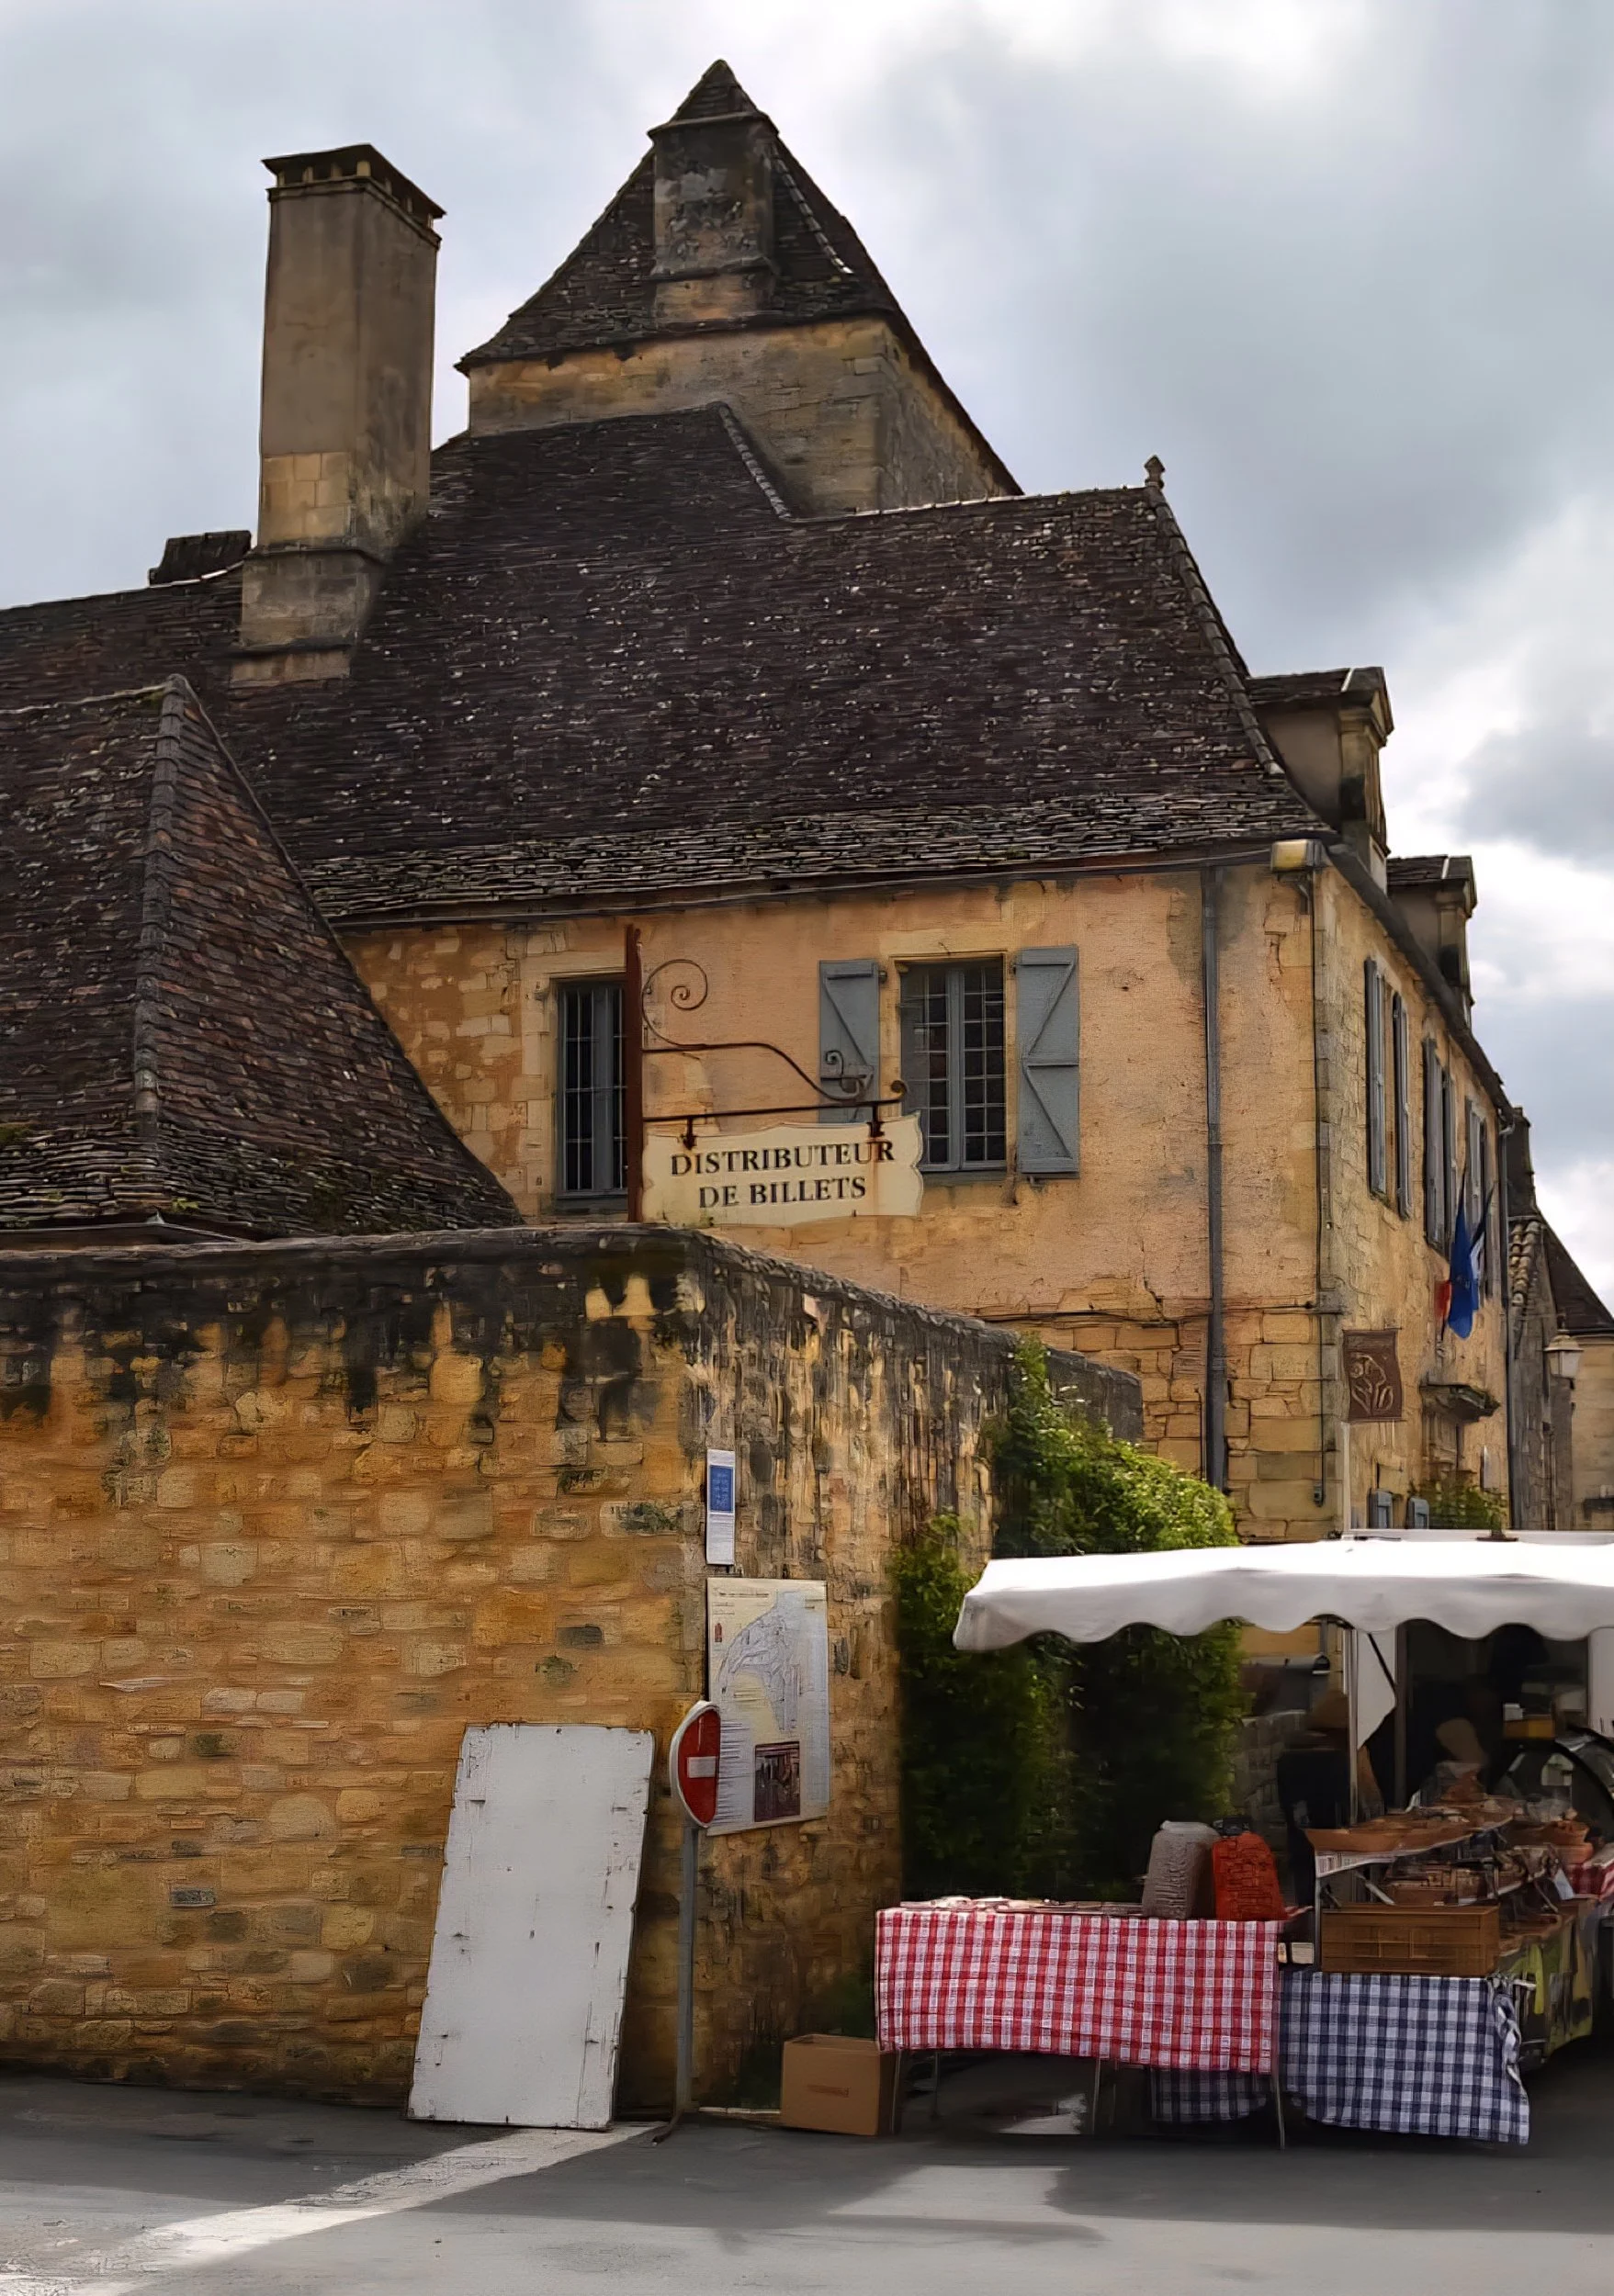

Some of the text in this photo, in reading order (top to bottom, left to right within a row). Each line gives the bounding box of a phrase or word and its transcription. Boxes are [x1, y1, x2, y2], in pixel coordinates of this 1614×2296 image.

[671, 1141, 895, 1176] DISTRIBUTEUR
[699, 1176, 866, 1209] DE BILLETS
